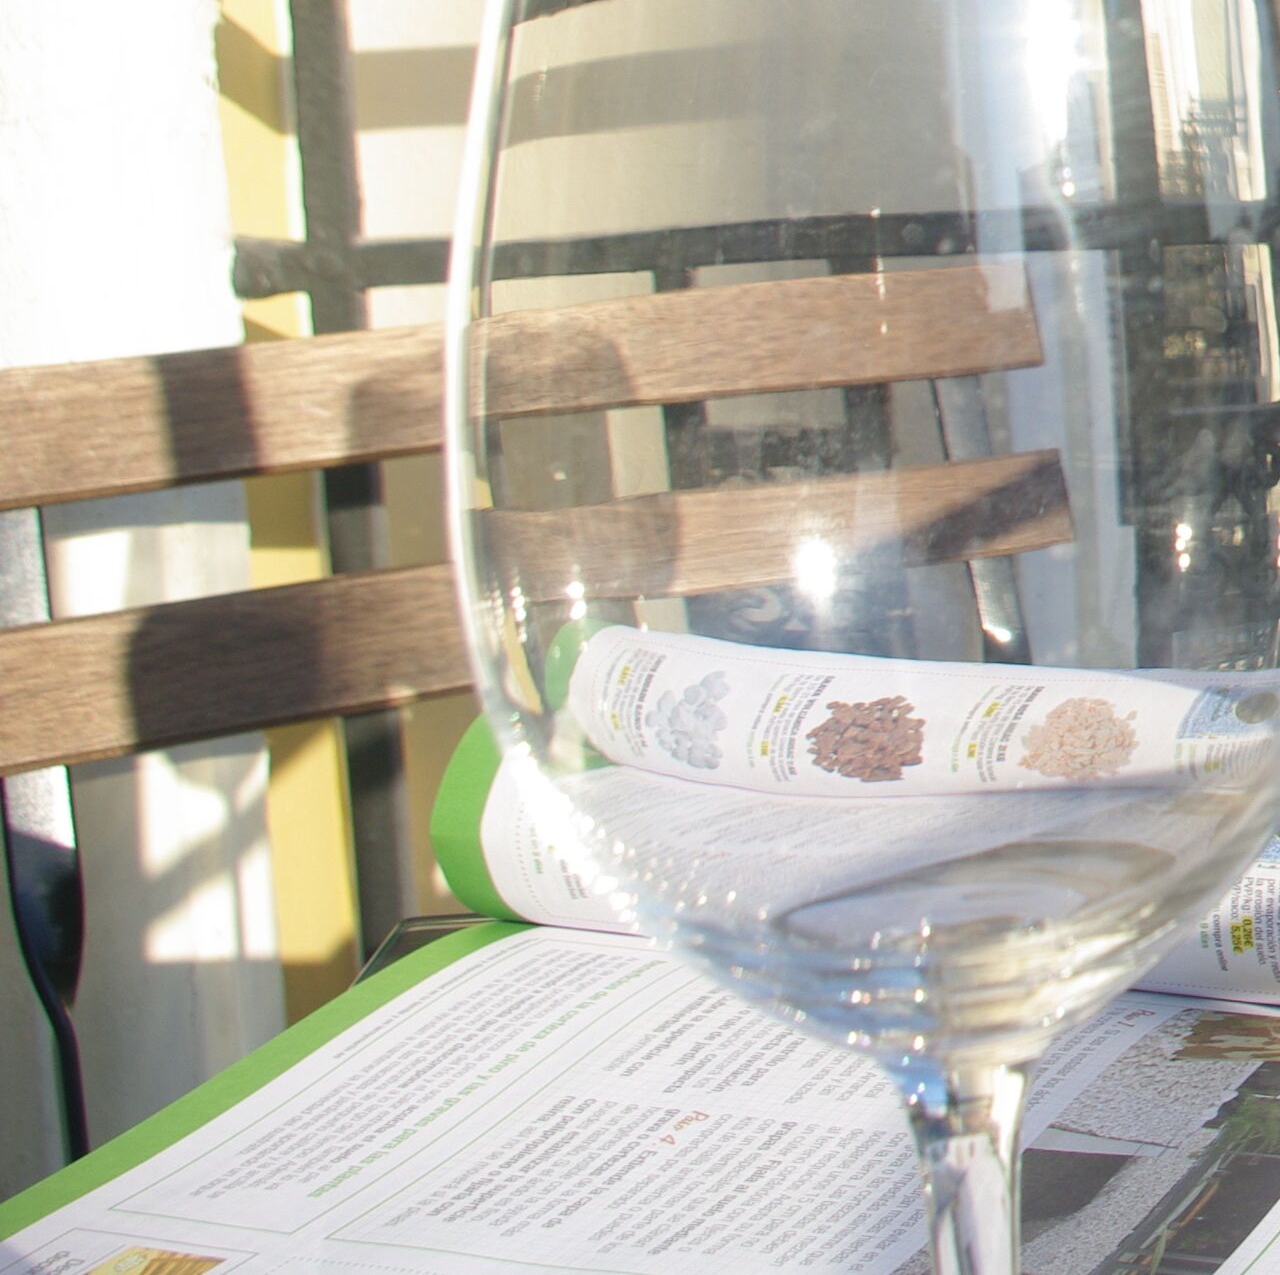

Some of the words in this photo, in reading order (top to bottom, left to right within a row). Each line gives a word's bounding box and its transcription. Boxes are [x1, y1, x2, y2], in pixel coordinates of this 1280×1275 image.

[1265, 880, 1275, 895] por
[1255, 890, 1265, 923] erosión
[1211, 916, 1224, 947] compra
[1255, 928, 1265, 940] del
[1266, 899, 1280, 952] evaporación
[1231, 926, 1243, 954] 5,25€
[589, 991, 608, 1000] de
[496, 995, 534, 1018] medida
[532, 1011, 578, 1039] corteza
[462, 1034, 478, 1042] se
[704, 1031, 722, 1041] de
[515, 1041, 536, 1052] de
[766, 1038, 806, 1066] rastrillo
[398, 1043, 464, 1088] descompone
[488, 1054, 520, 1073] pino
[663, 1054, 716, 1093] compacta
[741, 1068, 768, 1086] para
[457, 1082, 485, 1096] las
[414, 1098, 461, 1127] gravas
[572, 1098, 597, 1114] con
[576, 1101, 618, 1129] puedes
[620, 1104, 638, 1114] de
[374, 1105, 418, 1133] acolcha
[606, 1116, 624, 1126] un
[646, 1109, 680, 1132] grava
[752, 1119, 776, 1134] con
[675, 1114, 732, 1157] comprarlas
[717, 1132, 736, 1143] de
[758, 1122, 797, 1150] grapas
[801, 1124, 820, 1134] un
[827, 1126, 842, 1134] al
[836, 1128, 864, 1149] dejar
[382, 1129, 417, 1149] para
[499, 1116, 574, 1169] polipropileno
[500, 1139, 521, 1149] no
[738, 1135, 757, 1146] un
[330, 1144, 364, 1163] suelo
[360, 1151, 389, 1164] las
[486, 1152, 504, 1160] se
[519, 1131, 579, 1173] estabilizar
[589, 1141, 640, 1176] cortezas
[688, 1144, 722, 1165] malla
[792, 1136, 834, 1164] terreno
[551, 1159, 570, 1167] Si
[603, 1150, 657, 1185] Extiende
[657, 1159, 679, 1172] por
[307, 1165, 363, 1197] plantas
[539, 1169, 554, 1177] el
[812, 1171, 843, 1190] unos
[451, 1178, 493, 1200] fijarla
[538, 1181, 563, 1195] con
[573, 1178, 592, 1188] de
[589, 1187, 609, 1195] la
[639, 1167, 693, 1205] antihierba
[732, 1184, 749, 1193] al
[741, 1166, 797, 1206] cortándola
[443, 1185, 507, 1222] superficie
[493, 1197, 513, 1207] es
[662, 1181, 704, 1208] forman
[797, 1194, 820, 1203] 15
[427, 1202, 454, 1216] con
[527, 1198, 567, 1219] forma
[559, 1197, 592, 1216] capa
[682, 1197, 707, 1212] que
[702, 1195, 737, 1217] suelo
[749, 1194, 791, 1221] Adapta
[780, 1205, 802, 1218] cm
[489, 1204, 528, 1226] ayuda
[542, 1218, 562, 1228] de
[632, 1209, 665, 1229] parte
[667, 1213, 686, 1223] se
[720, 1208, 746, 1222] con
[500, 1221, 531, 1237] más
[588, 1213, 633, 1241] puedes
[615, 1231, 635, 1241] de
[632, 1224, 671, 1247] clavan
[648, 1219, 705, 1254] mediante
[688, 1224, 727, 1245] tijeras
[734, 1222, 754, 1232] su
[755, 1219, 785, 1236] para
[597, 1242, 622, 1253] los
[702, 1233, 741, 1255] forma
[740, 1237, 760, 1247] no
